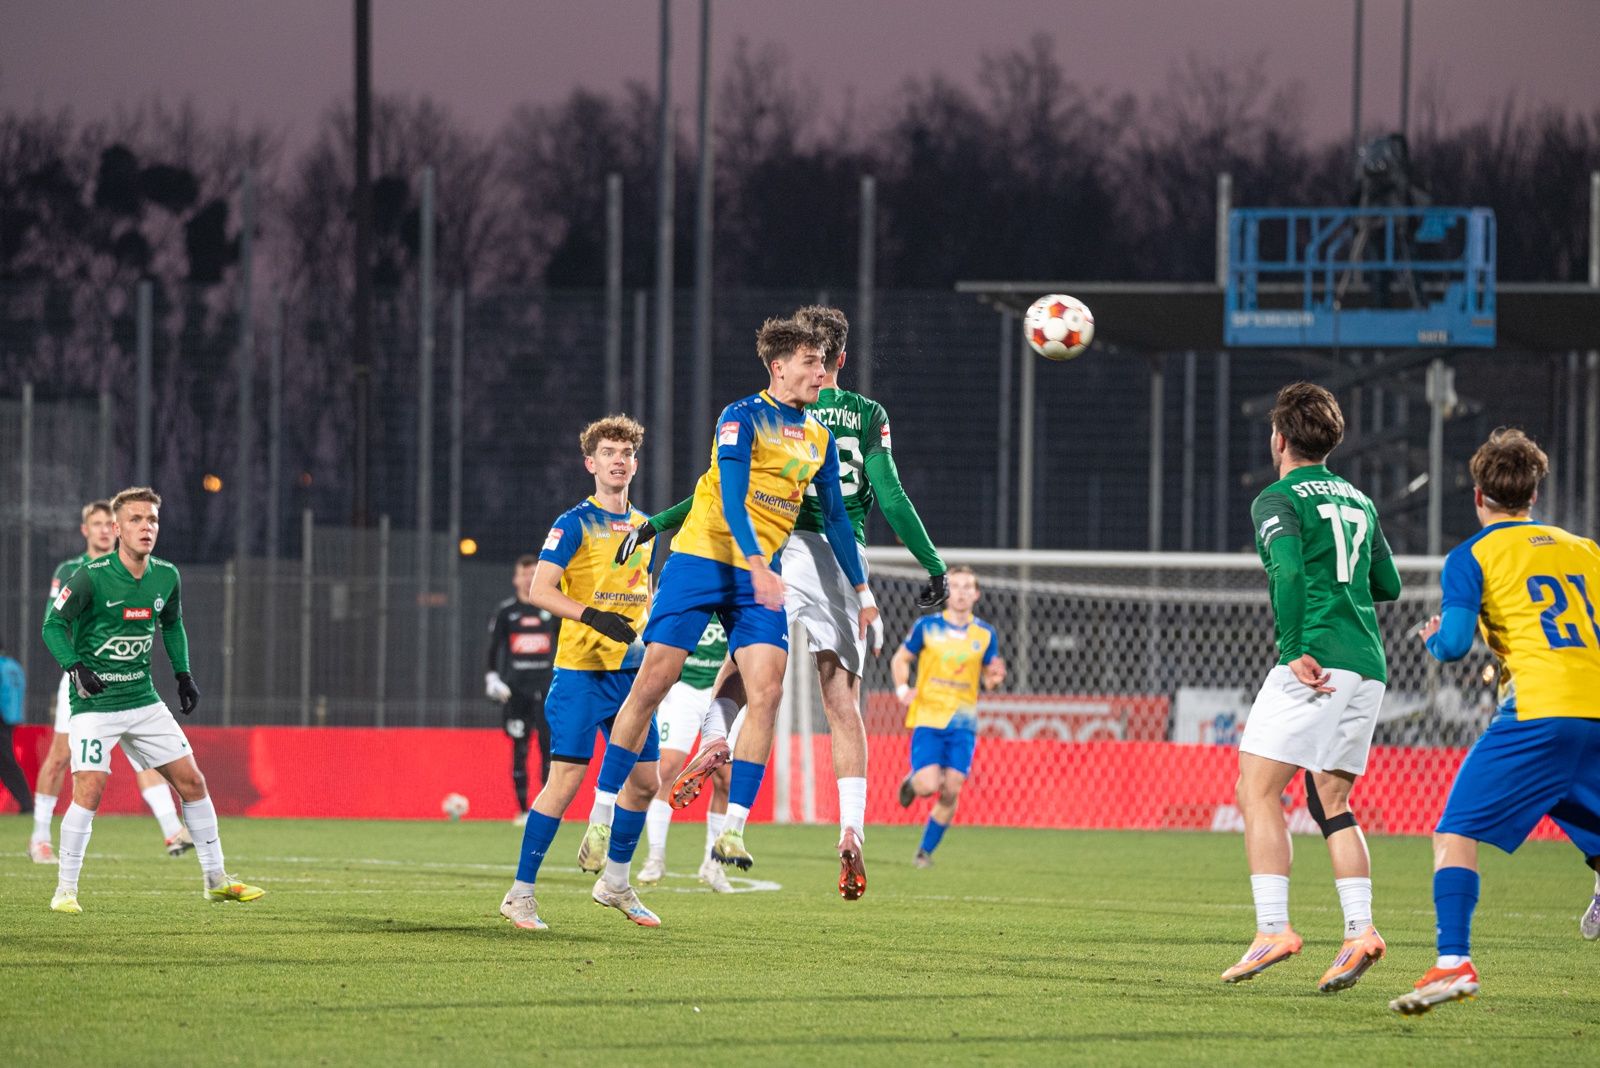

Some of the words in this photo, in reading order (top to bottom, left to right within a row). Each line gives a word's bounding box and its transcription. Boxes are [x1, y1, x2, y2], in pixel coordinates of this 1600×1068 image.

[1316, 503, 1367, 585] 17
[125, 608, 150, 618] Betclic
[1526, 573, 1600, 651] 21
[660, 721, 670, 742] 8
[80, 738, 102, 764] 13
